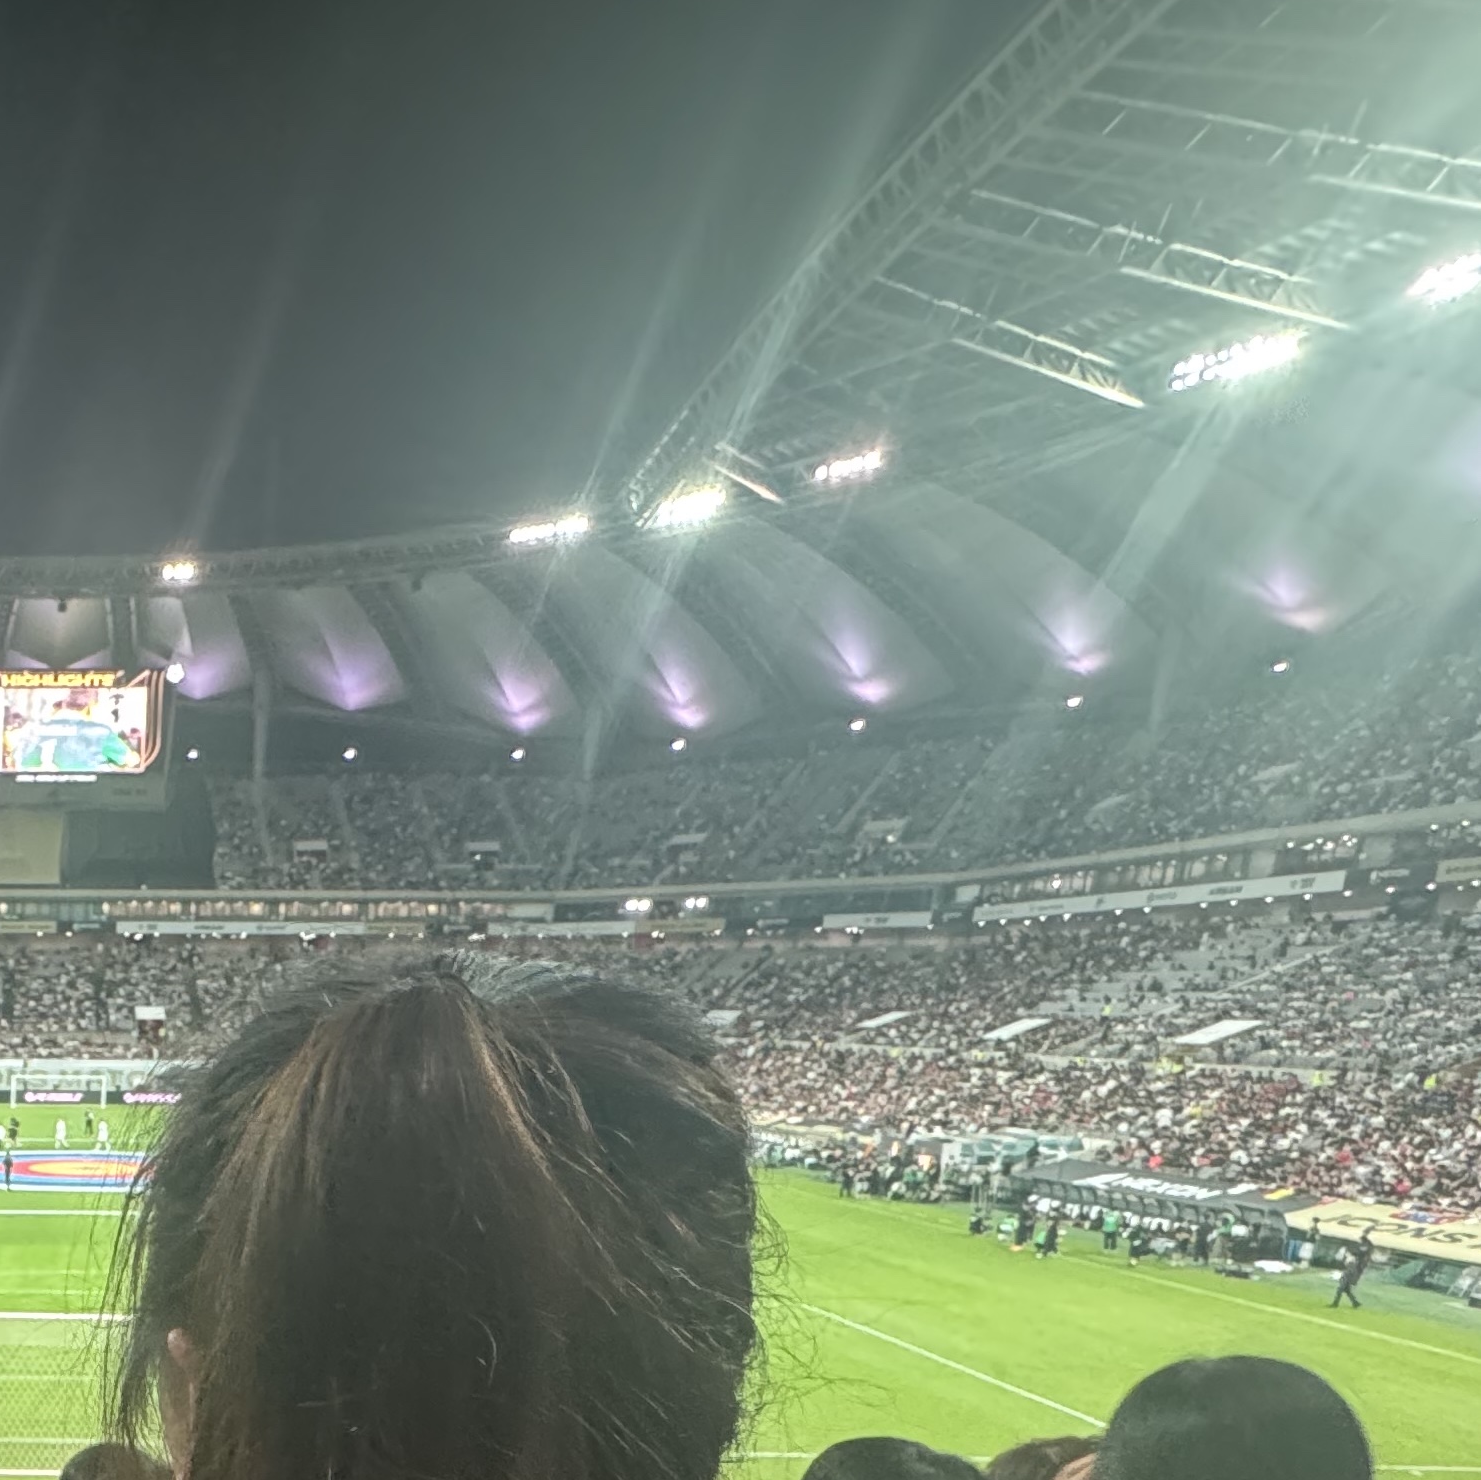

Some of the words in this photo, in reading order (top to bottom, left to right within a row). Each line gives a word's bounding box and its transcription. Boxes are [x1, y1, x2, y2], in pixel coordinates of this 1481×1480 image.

[1, 673, 116, 688] HIGHLIGHTS
[58, 1067, 149, 1088] MATC
[1320, 1214, 1478, 1244] ICONS
